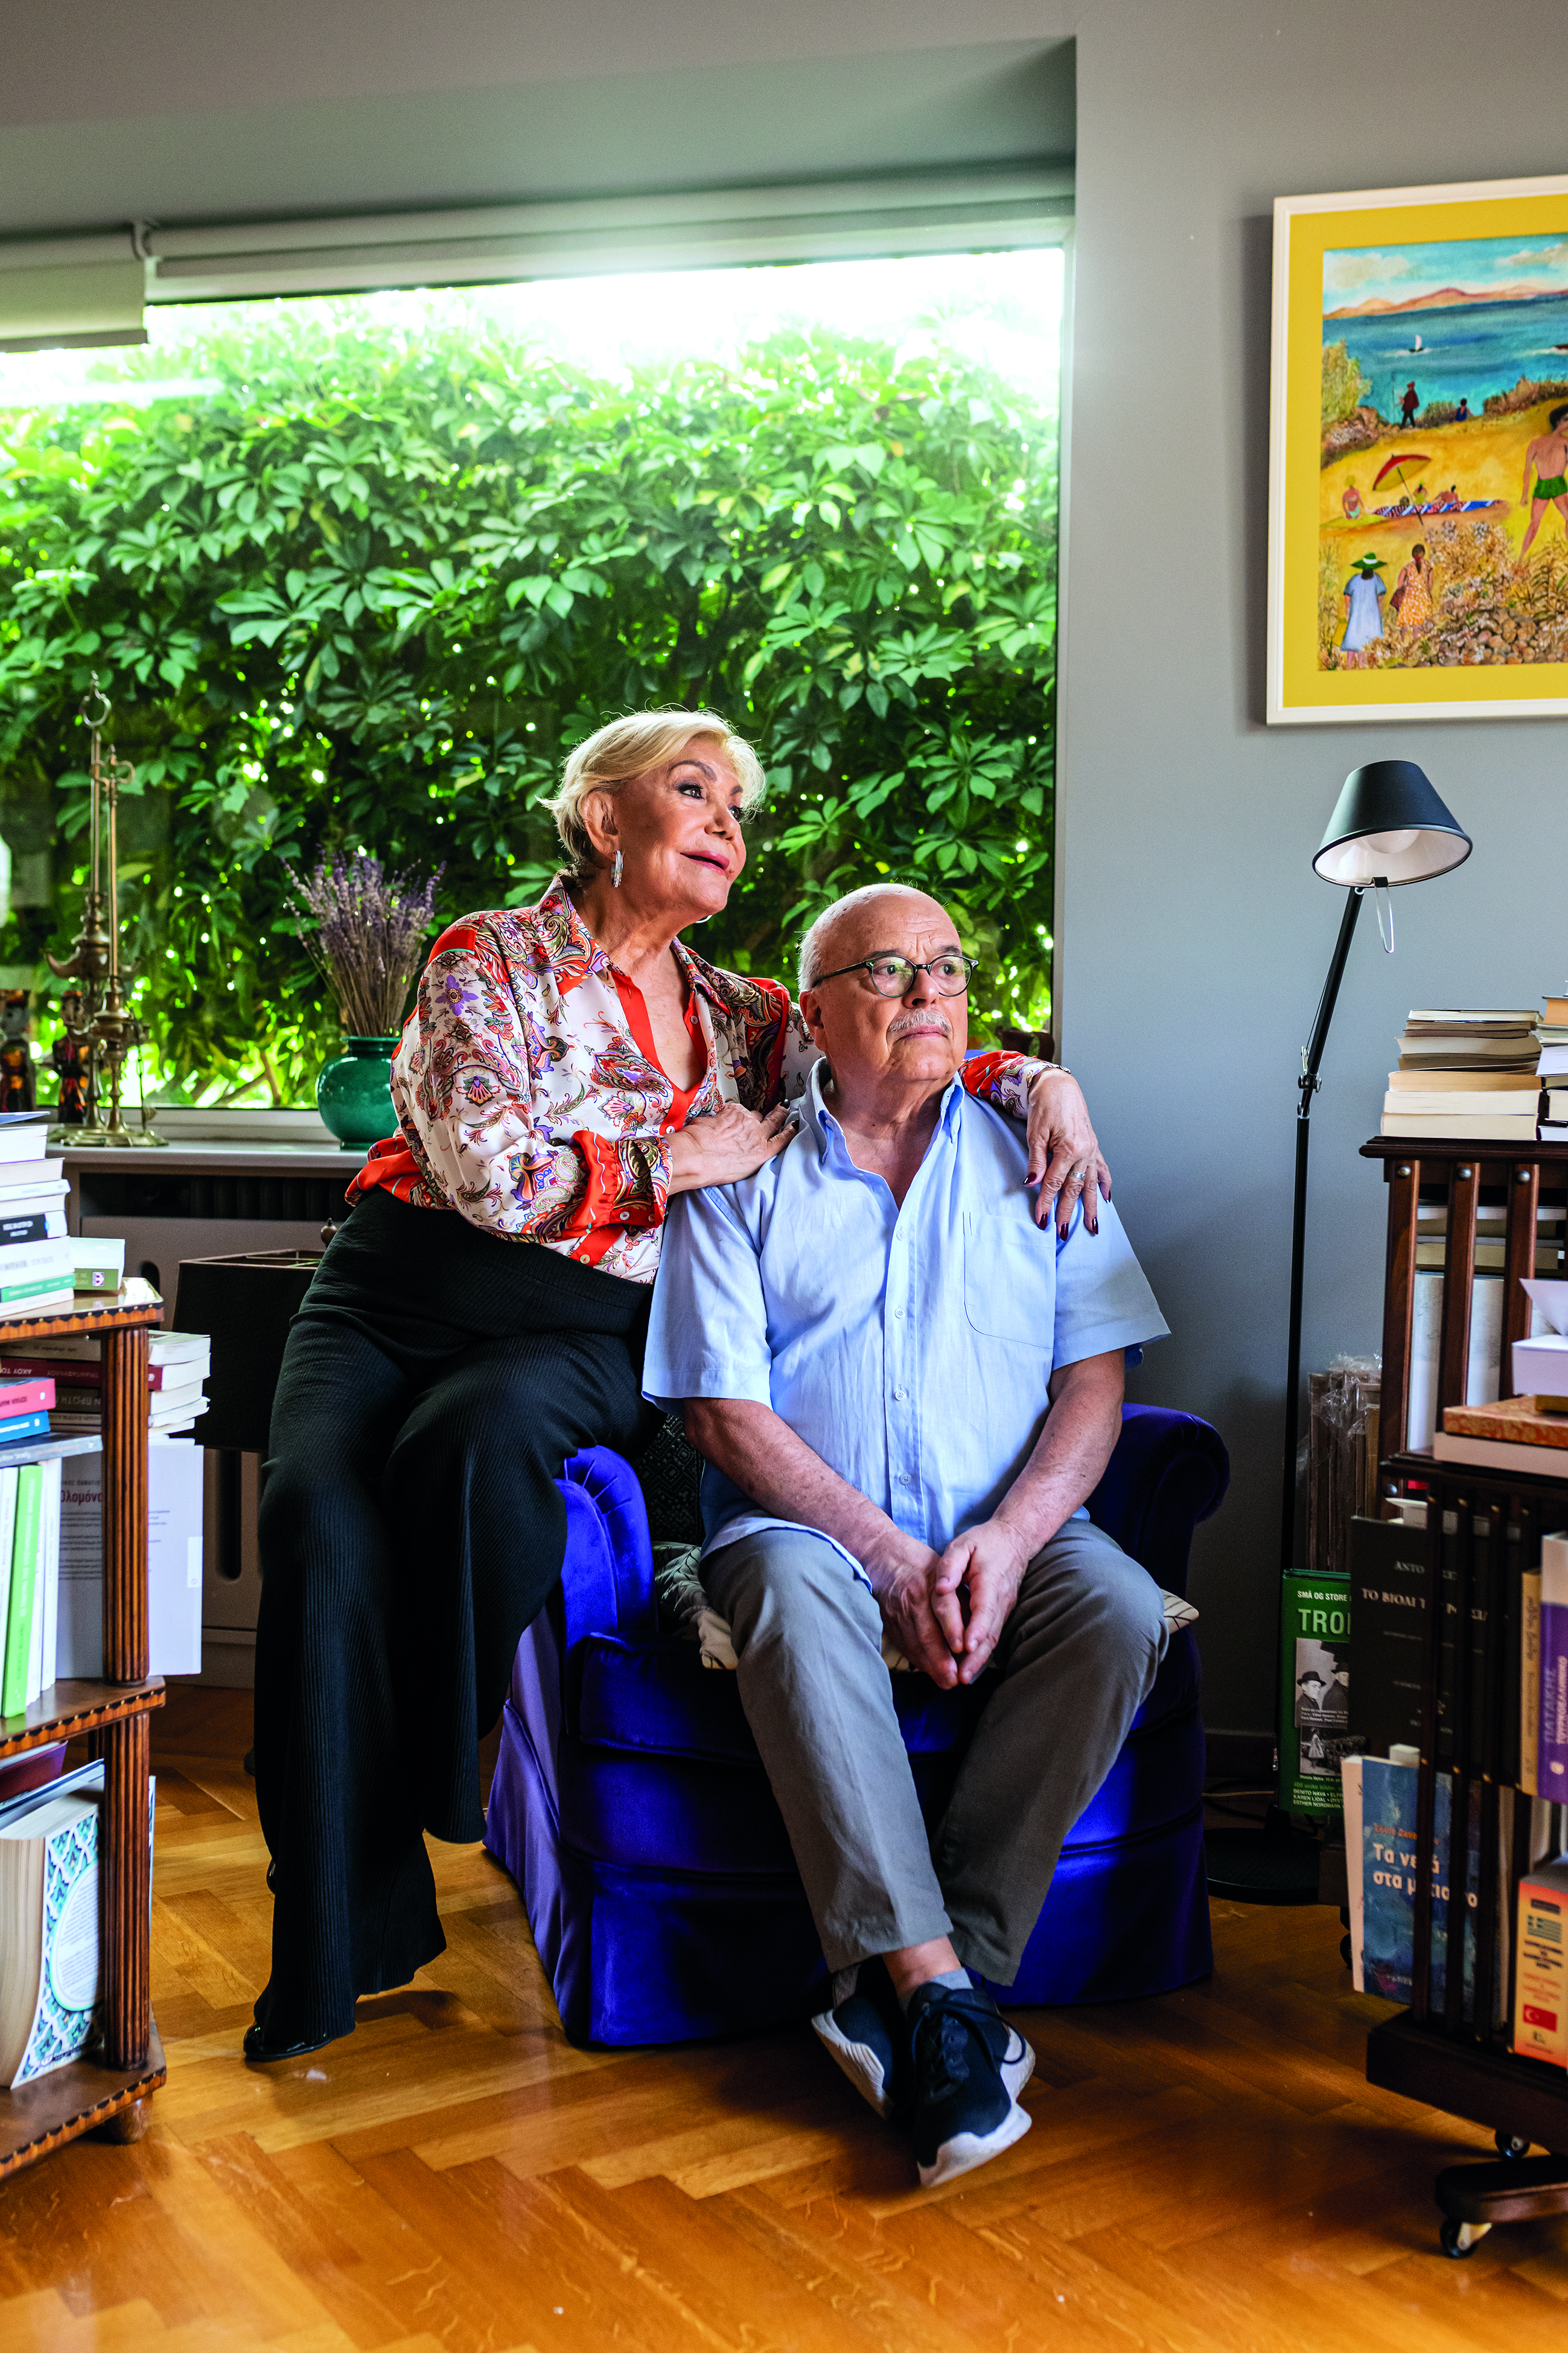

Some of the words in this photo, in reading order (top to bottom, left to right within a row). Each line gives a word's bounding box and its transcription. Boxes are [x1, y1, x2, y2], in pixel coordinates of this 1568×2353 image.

[1297, 1590, 1313, 1599] SMÅ
[1313, 1592, 1324, 1600] OG
[1325, 1592, 1348, 1601] STORE
[1373, 1843, 1395, 1864] Τα
[1400, 1851, 1440, 1875] νεά
[1373, 1871, 1402, 1889] στα
